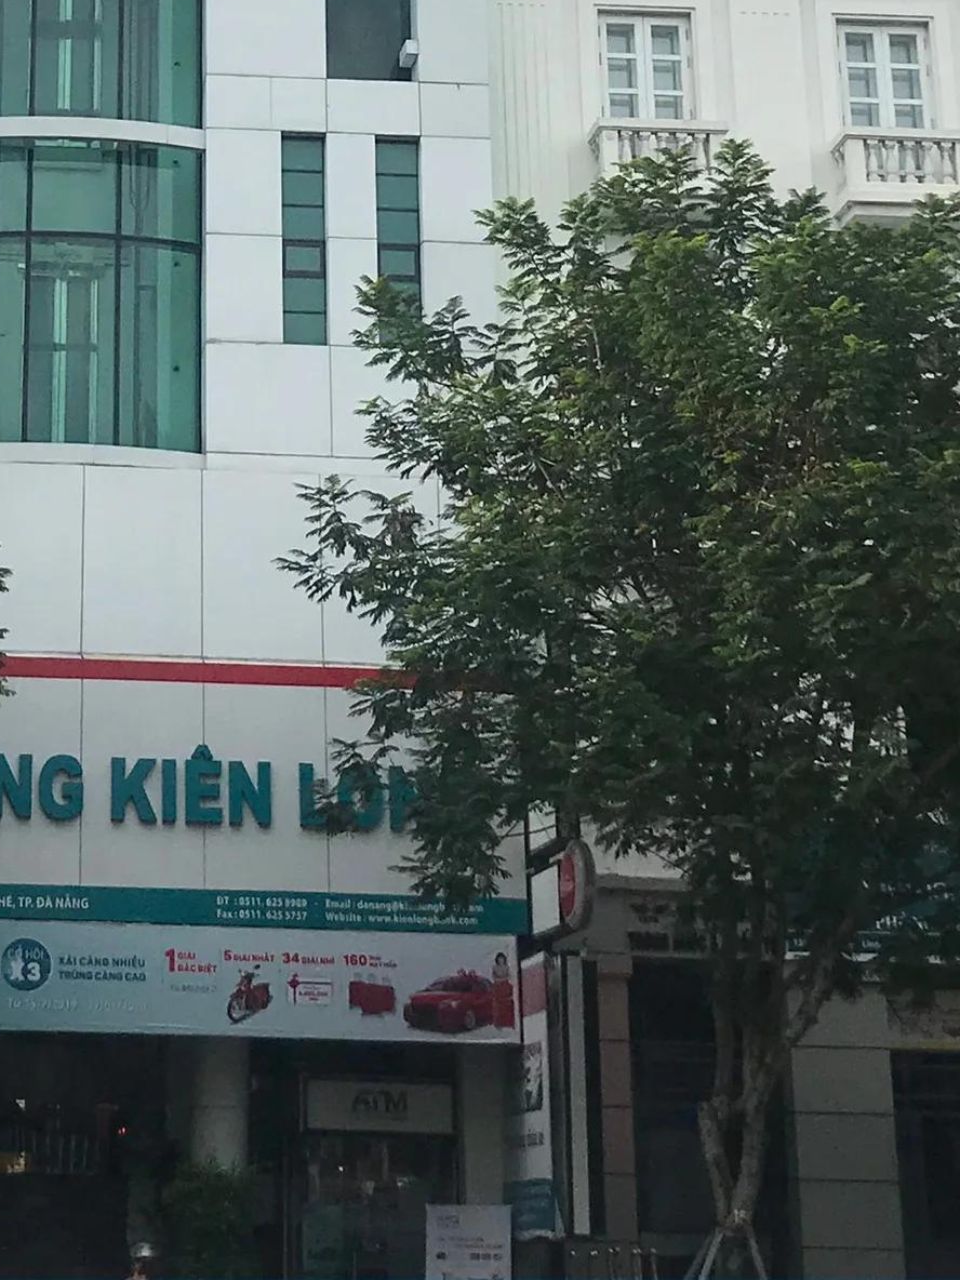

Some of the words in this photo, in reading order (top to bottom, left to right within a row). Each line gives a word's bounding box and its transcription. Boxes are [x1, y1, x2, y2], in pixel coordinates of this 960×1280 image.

[110, 744, 271, 828] KIÊN
[282, 952, 300, 964] 34
[343, 954, 367, 967] 160
